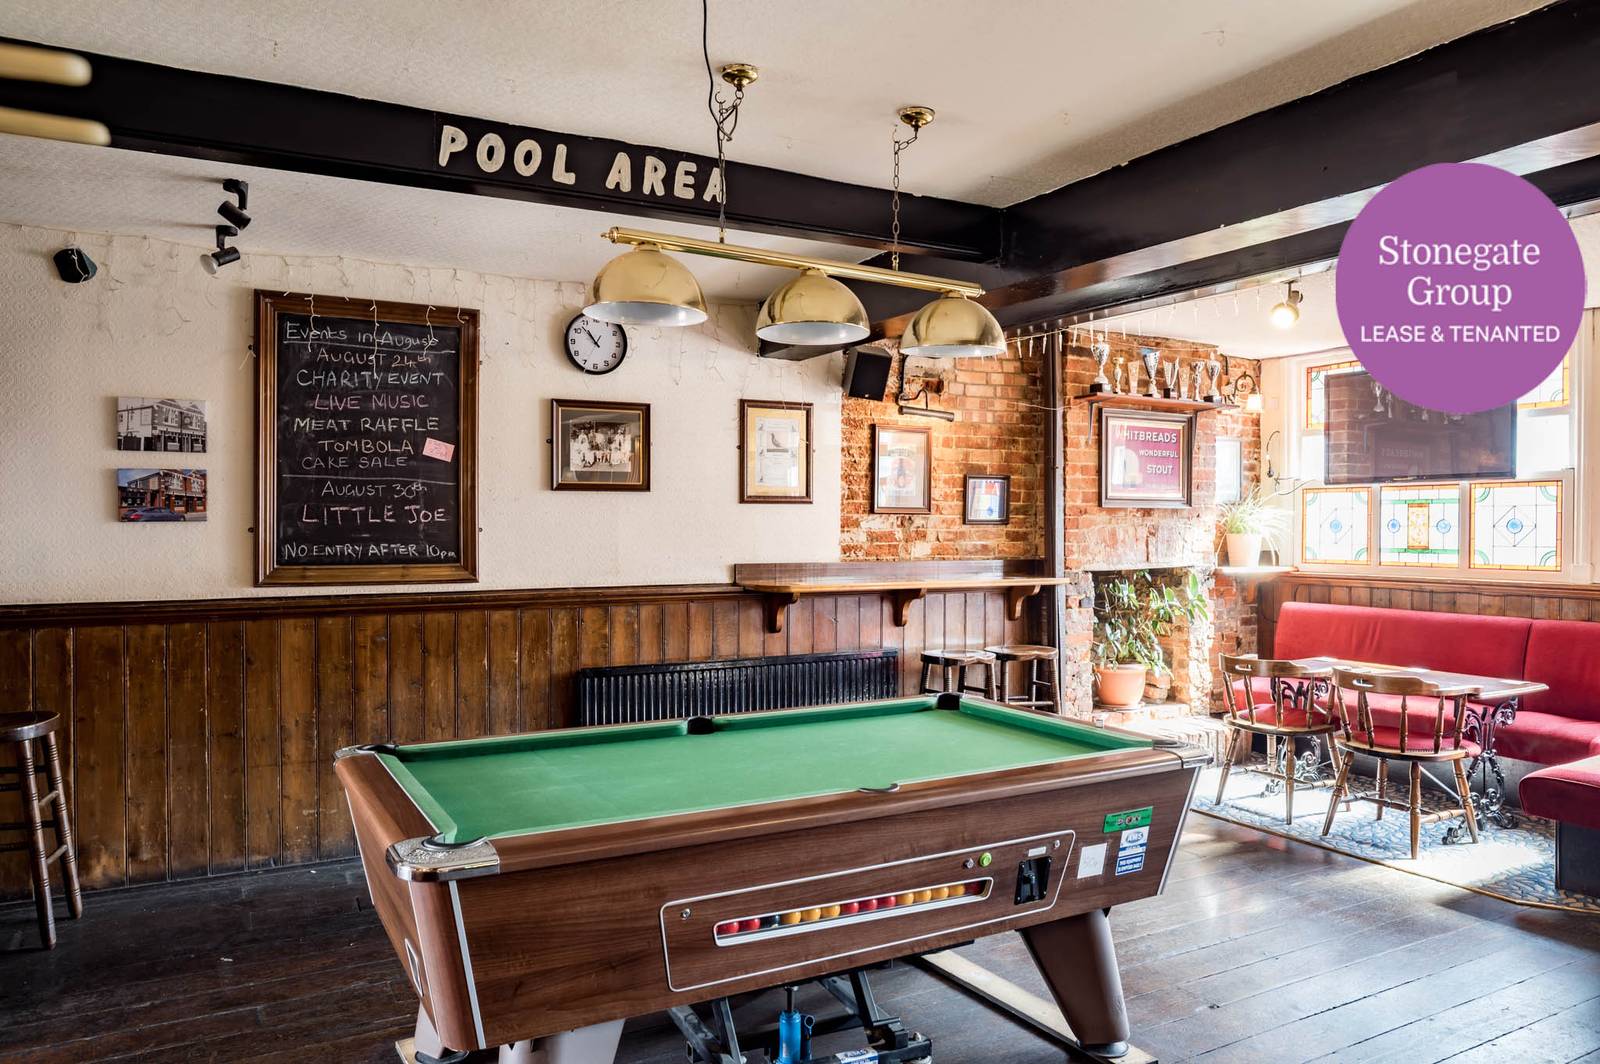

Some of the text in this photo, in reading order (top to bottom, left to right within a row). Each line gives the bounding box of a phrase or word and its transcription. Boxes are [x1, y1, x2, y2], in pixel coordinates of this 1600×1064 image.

[438, 124, 727, 205] POOL AREA
[285, 321, 348, 340] Events
[358, 331, 373, 343] in
[316, 348, 387, 366] AUGUST
[296, 370, 445, 390] CHARITY EVENT
[314, 393, 429, 410] LIVE MUSIC
[293, 417, 440, 433] MEAT RAFFLE
[317, 439, 414, 454] TOMBOLA
[1138, 449, 1179, 458] WONDERFUL
[301, 456, 408, 470] CAKE SALE
[1146, 464, 1173, 475] STOUT
[321, 481, 387, 497] AUGUST
[302, 504, 448, 526] LITTLE JOE
[284, 541, 308, 560] NO
[313, 543, 363, 559] ENTRY
[368, 543, 419, 557] AFTER
